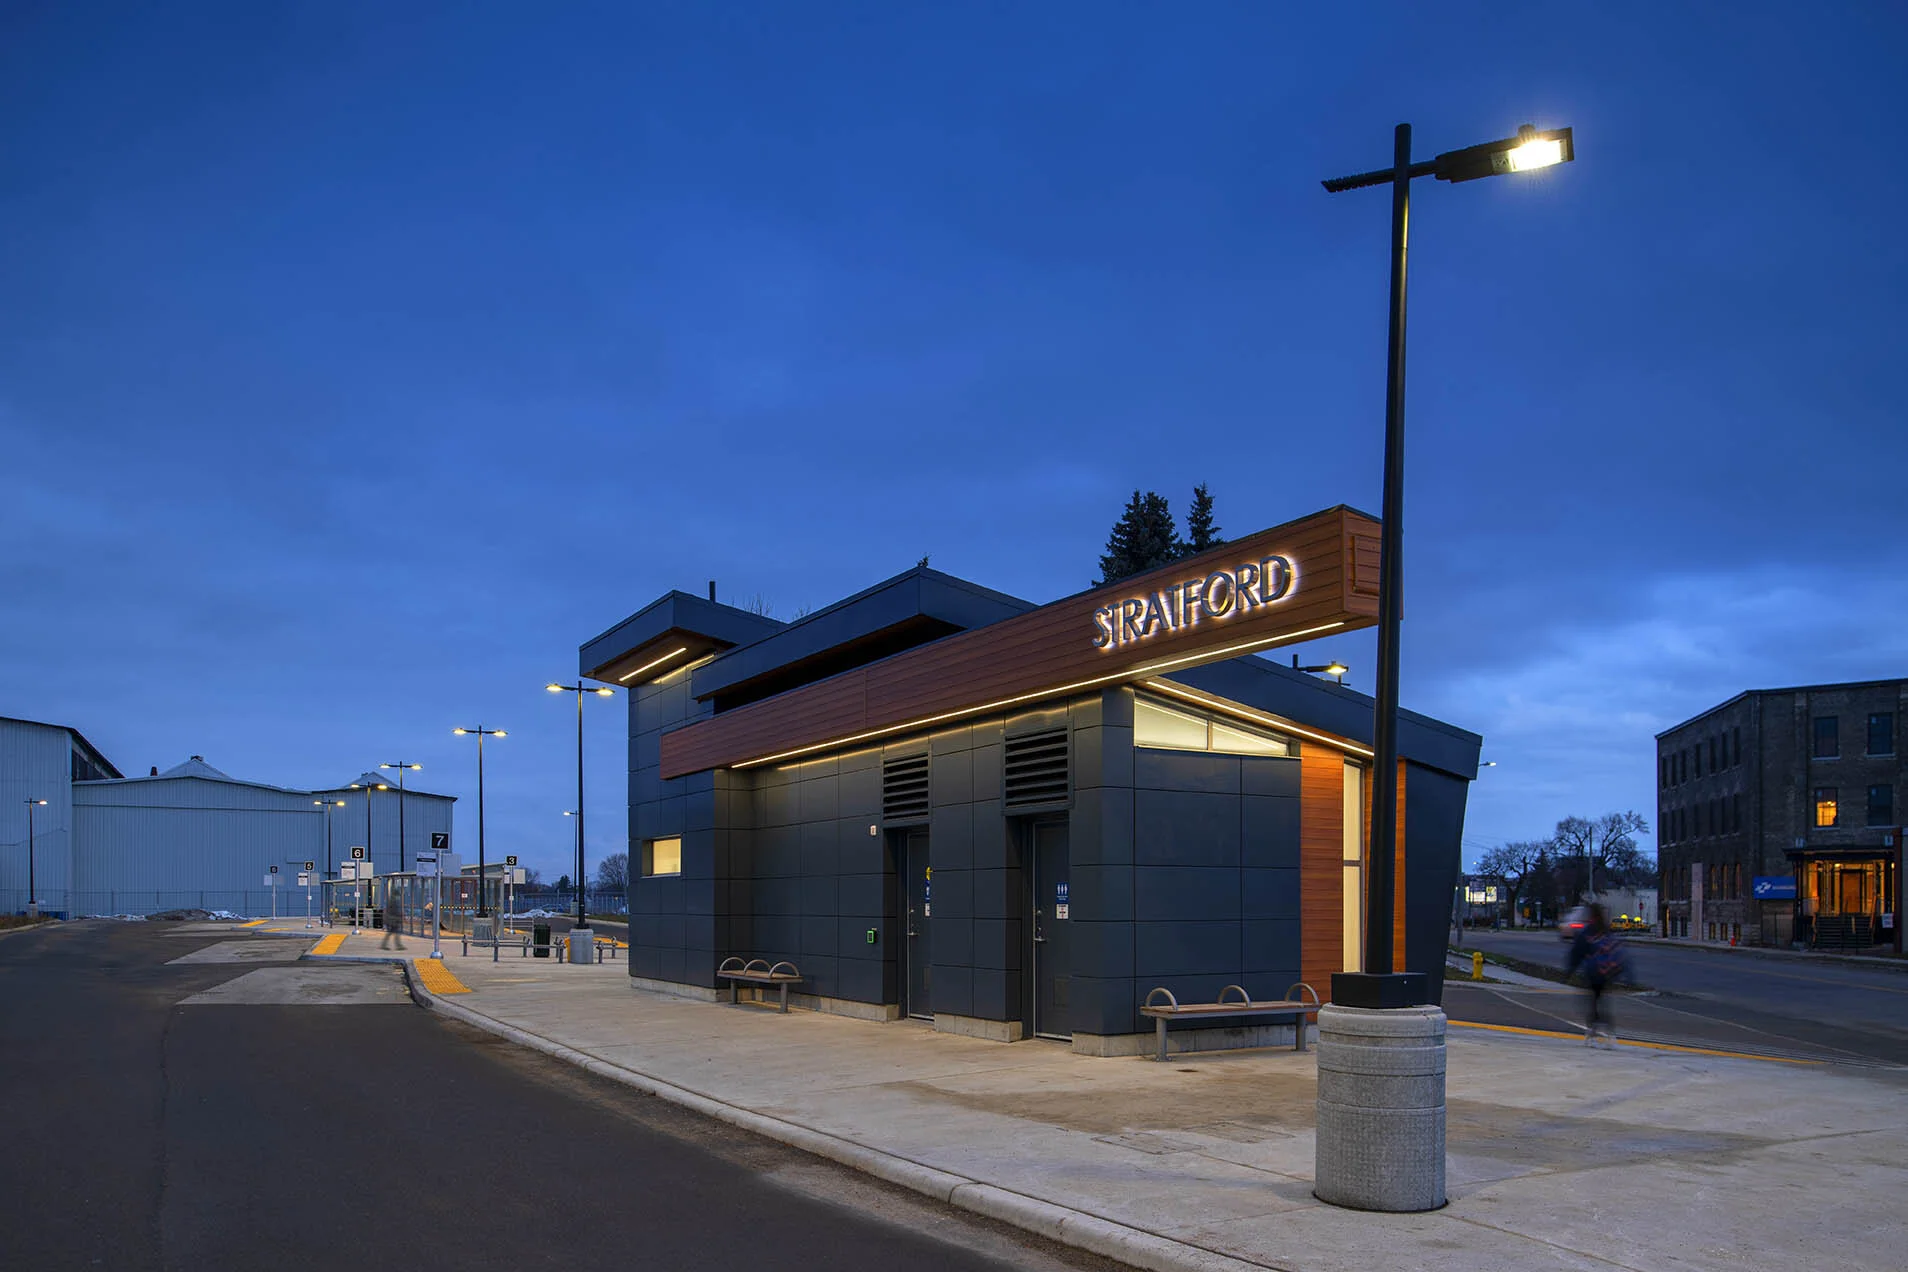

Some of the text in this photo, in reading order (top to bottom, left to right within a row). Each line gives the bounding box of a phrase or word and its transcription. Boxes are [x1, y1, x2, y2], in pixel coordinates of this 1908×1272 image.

[1092, 555, 1292, 647] STRATFORD
[436, 835, 445, 847] 7
[354, 849, 361, 857] 6
